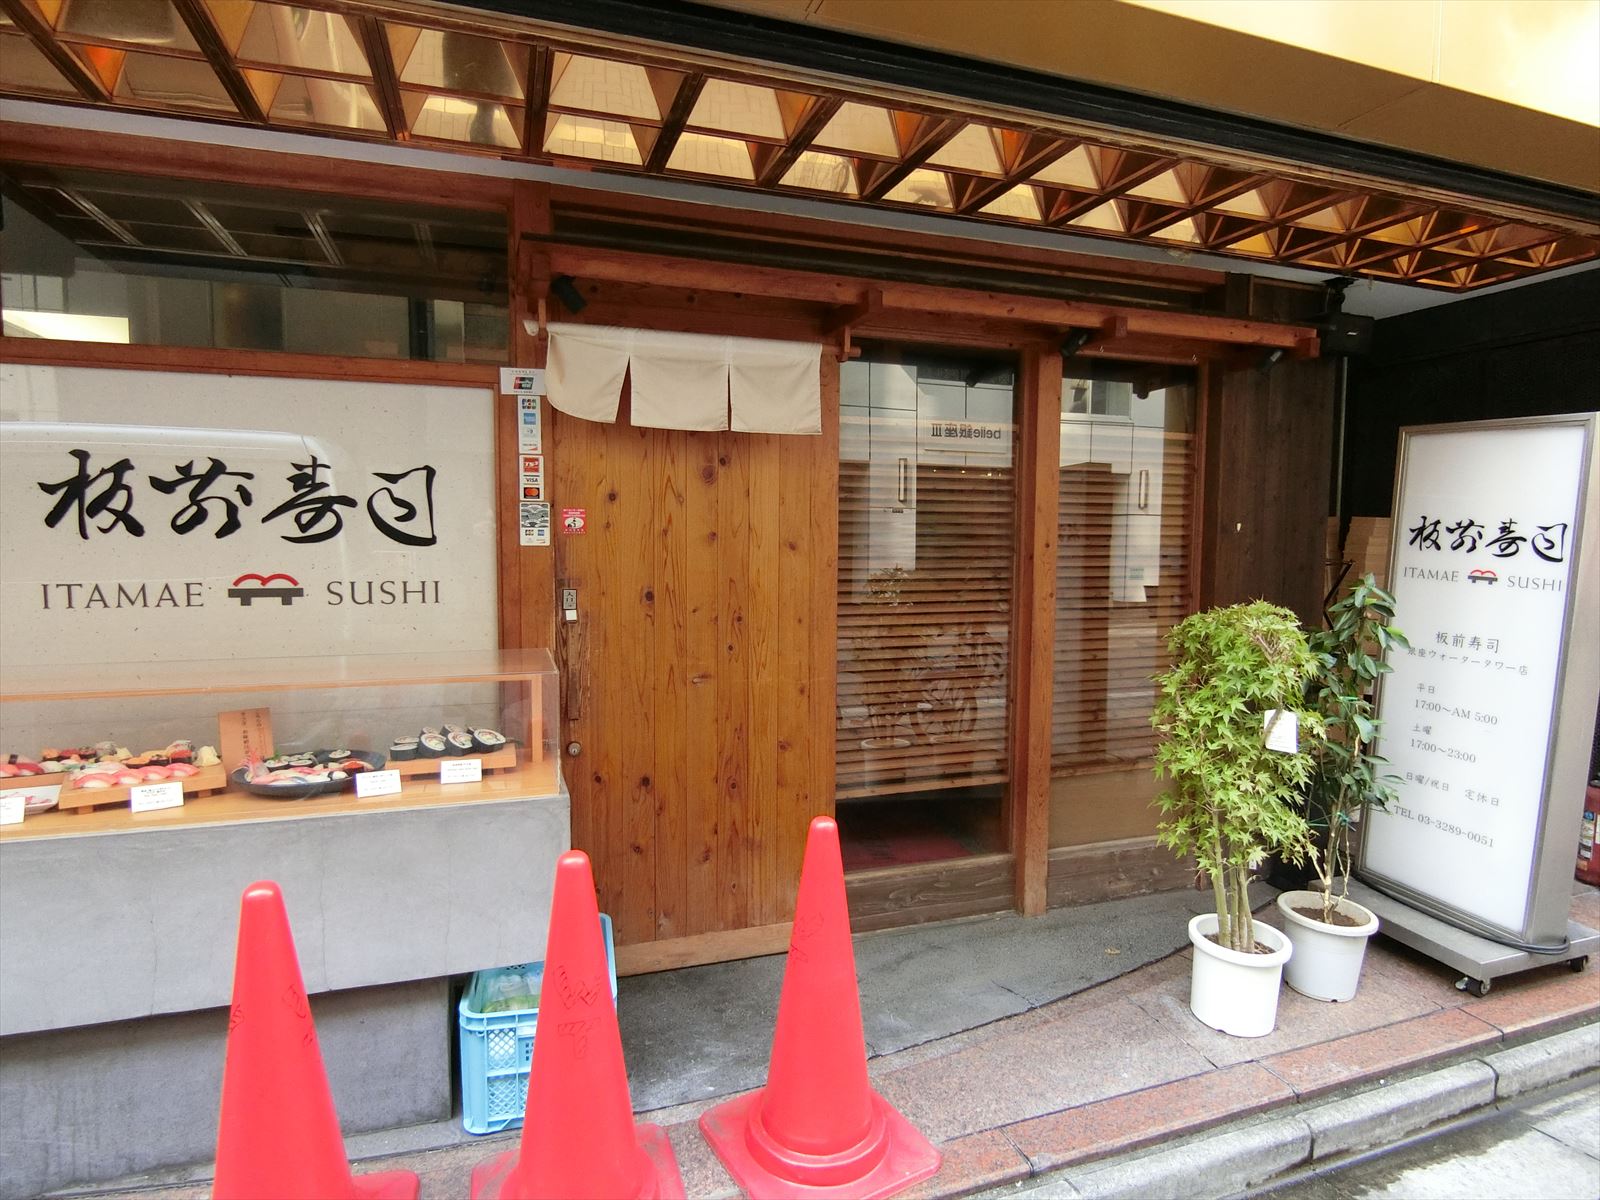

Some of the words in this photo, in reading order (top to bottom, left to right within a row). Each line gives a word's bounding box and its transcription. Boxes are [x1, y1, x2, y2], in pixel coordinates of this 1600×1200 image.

[38, 449, 437, 546] 板前寿司
[1409, 515, 1568, 562] 板前寿司
[1403, 566, 1459, 582] ITAMAE
[1507, 575, 1562, 592] SUSHI
[42, 582, 205, 609] ITAMAE
[327, 580, 441, 606] SUSHI
[1436, 631, 1500, 653] 板前寿司
[1417, 682, 1436, 694] 平日
[1412, 723, 1432, 735] 土曜
[1474, 711, 1498, 725] 5:00
[1464, 788, 1500, 807] 定休日
[1393, 804, 1415, 820] TEL
[1417, 813, 1494, 848] 03-3289-0051
